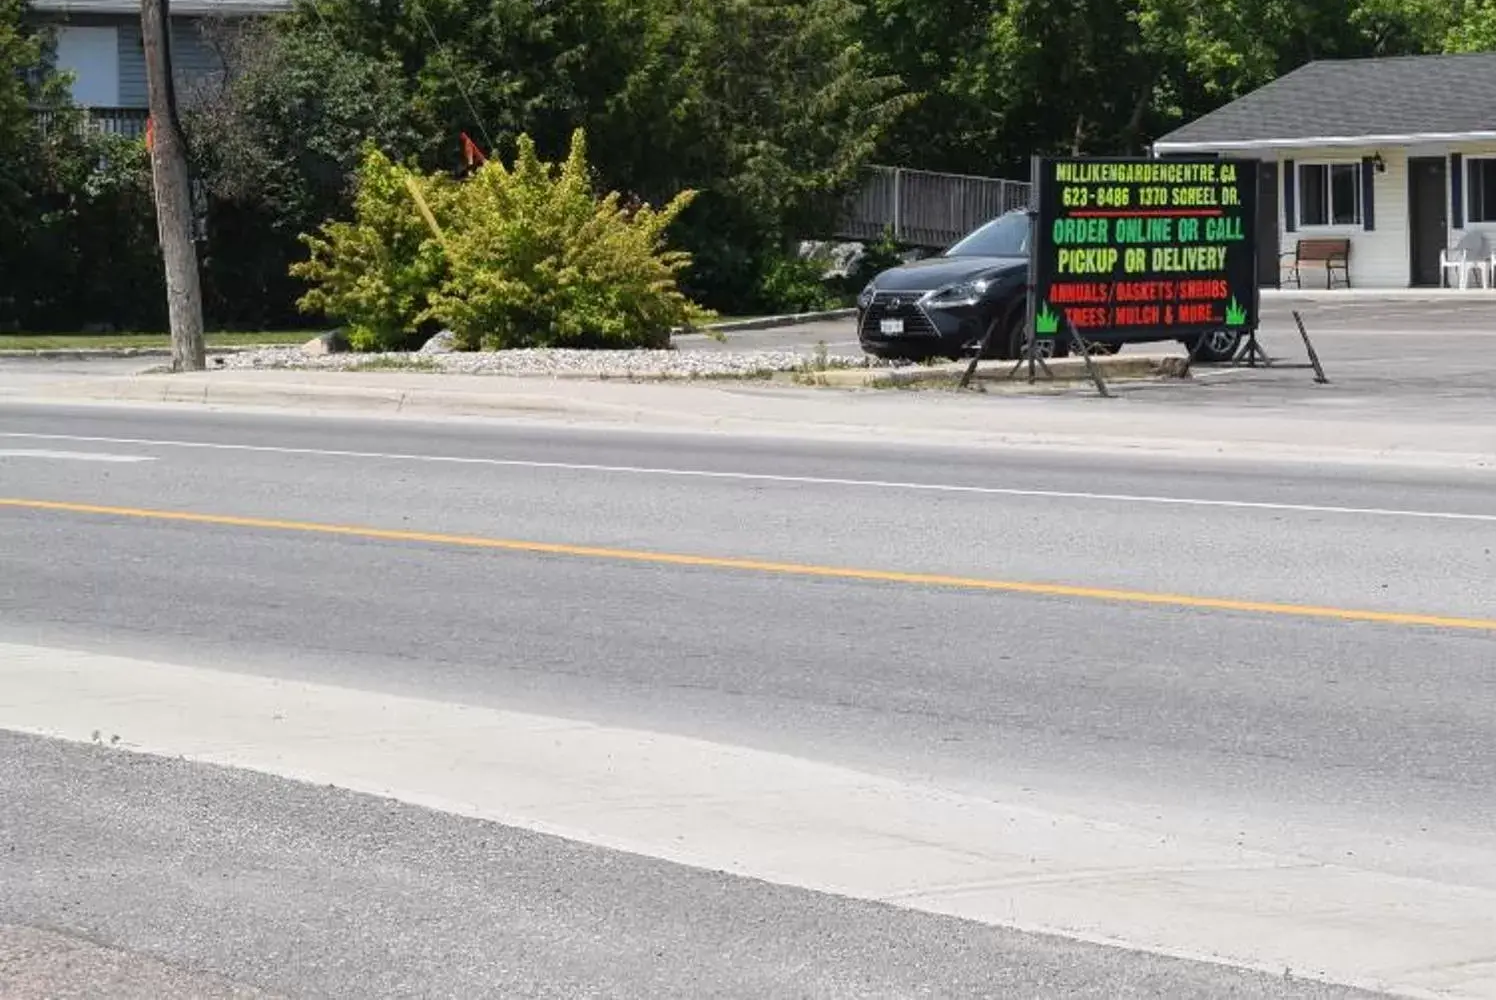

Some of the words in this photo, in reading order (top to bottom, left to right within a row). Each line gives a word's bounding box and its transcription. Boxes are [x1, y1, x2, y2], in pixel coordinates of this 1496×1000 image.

[1139, 188, 1167, 205] 1370
[1172, 187, 1217, 205] SCHEEL
[1053, 218, 1108, 243] ORDER
[1116, 218, 1171, 242] ONLINE
[1178, 218, 1199, 241] OR
[1206, 217, 1244, 241] CALL
[1058, 248, 1118, 273] PICKUP
[1125, 249, 1145, 272] OR
[1152, 247, 1227, 271] DELIVERY
